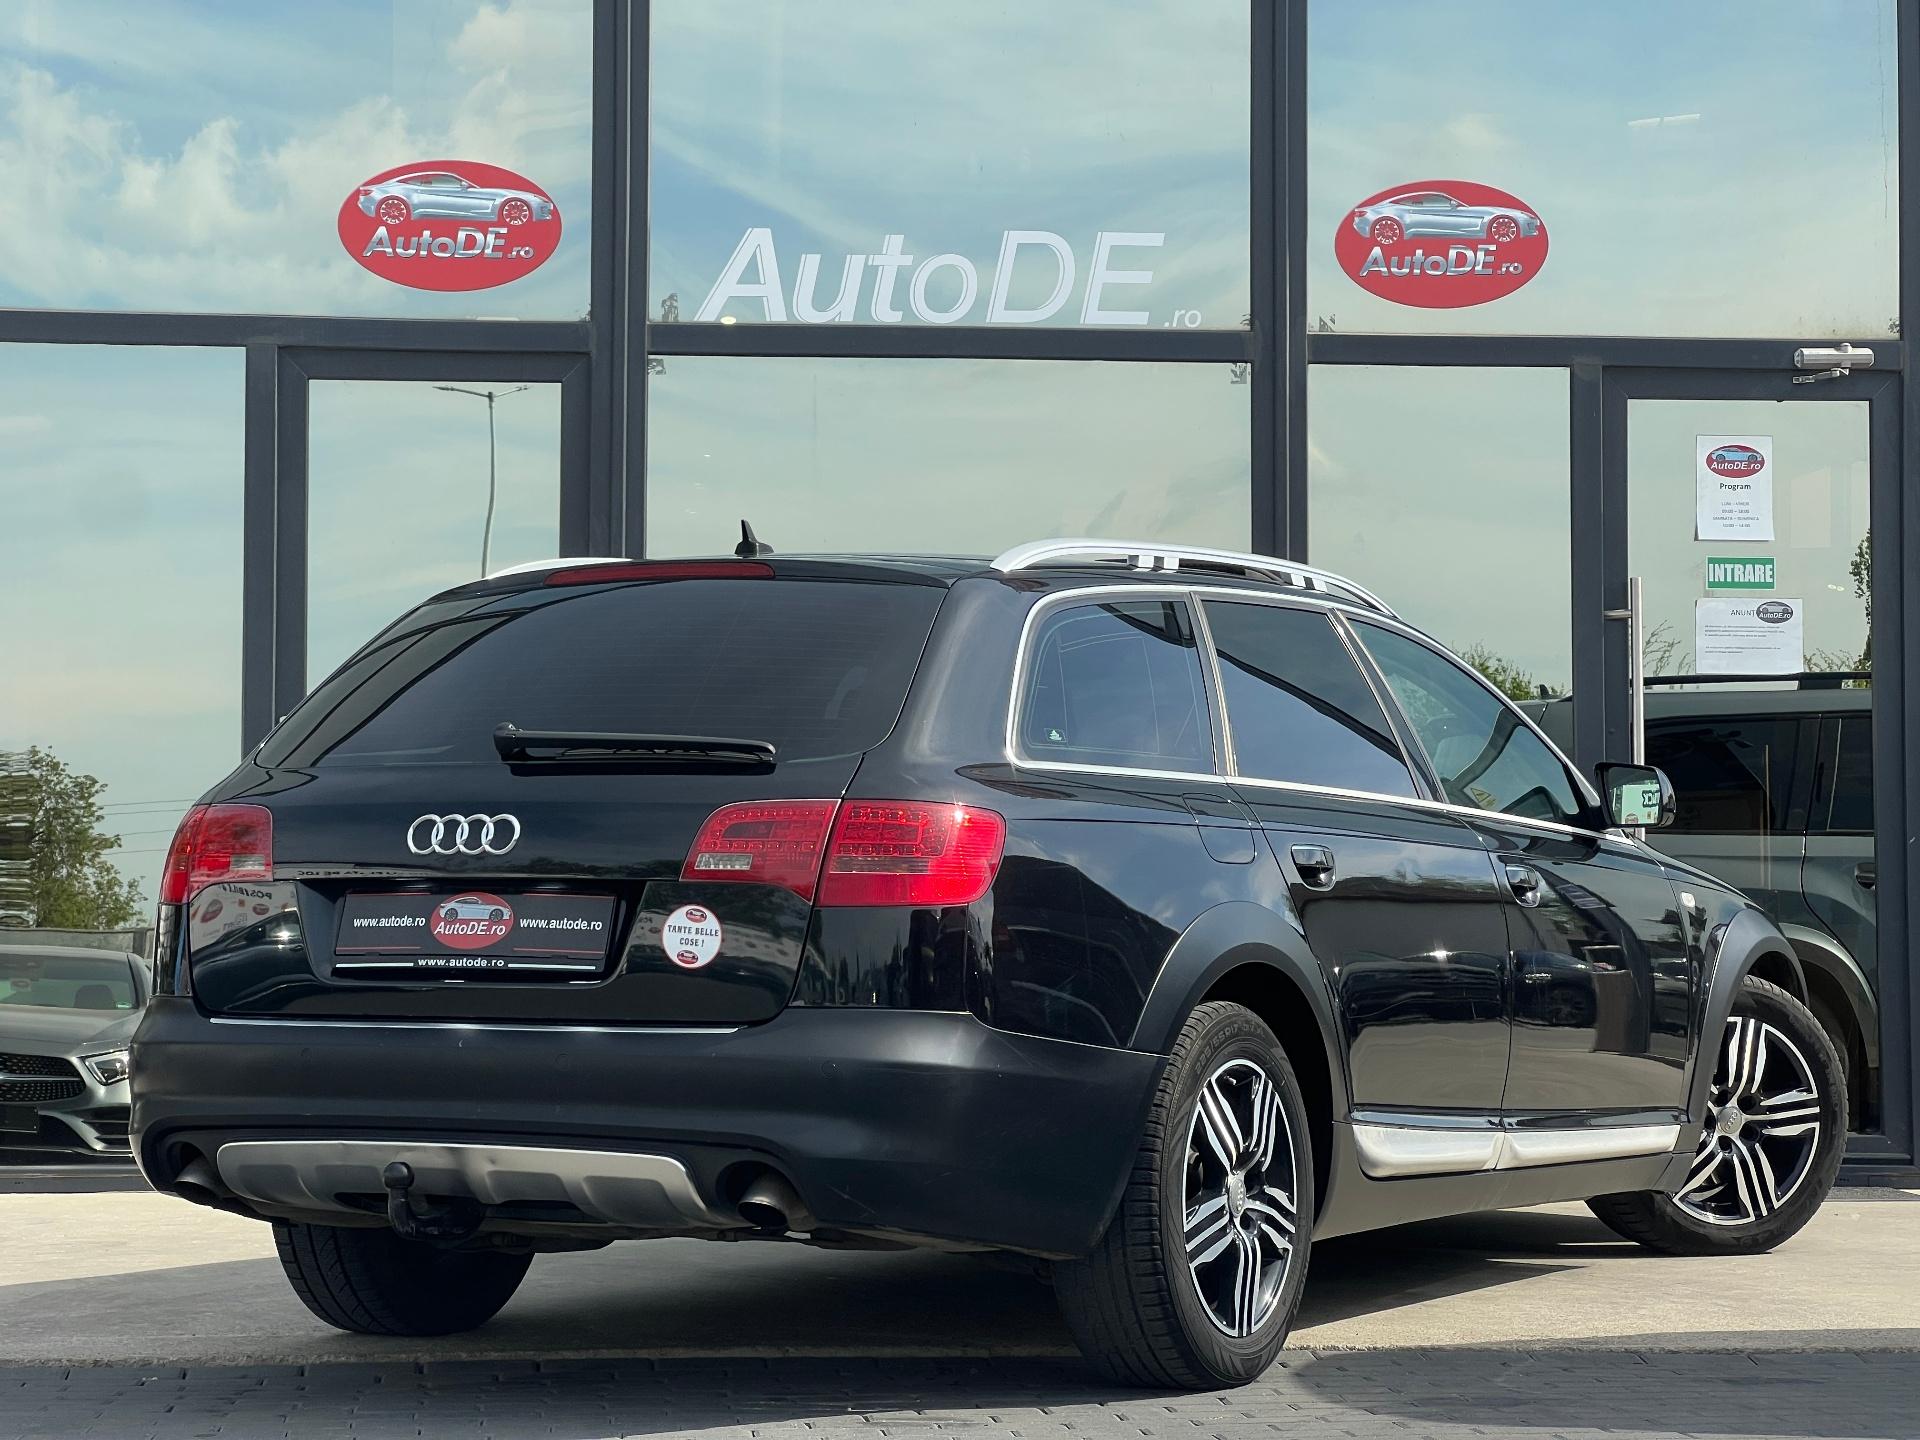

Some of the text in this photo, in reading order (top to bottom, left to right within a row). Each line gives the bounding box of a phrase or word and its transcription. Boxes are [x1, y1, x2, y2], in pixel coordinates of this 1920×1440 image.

[1710, 461, 1761, 470] AutoDE.ro
[1719, 482, 1752, 491] Program
[1708, 563, 1774, 583] INTRARE
[353, 915, 426, 928] www.autode.ro
[519, 917, 603, 931] www.autode.ro
[433, 921, 506, 936] AutoDE.ro
[667, 924, 720, 937] TANTE BELLE
[417, 957, 505, 967] www.autode.ro
